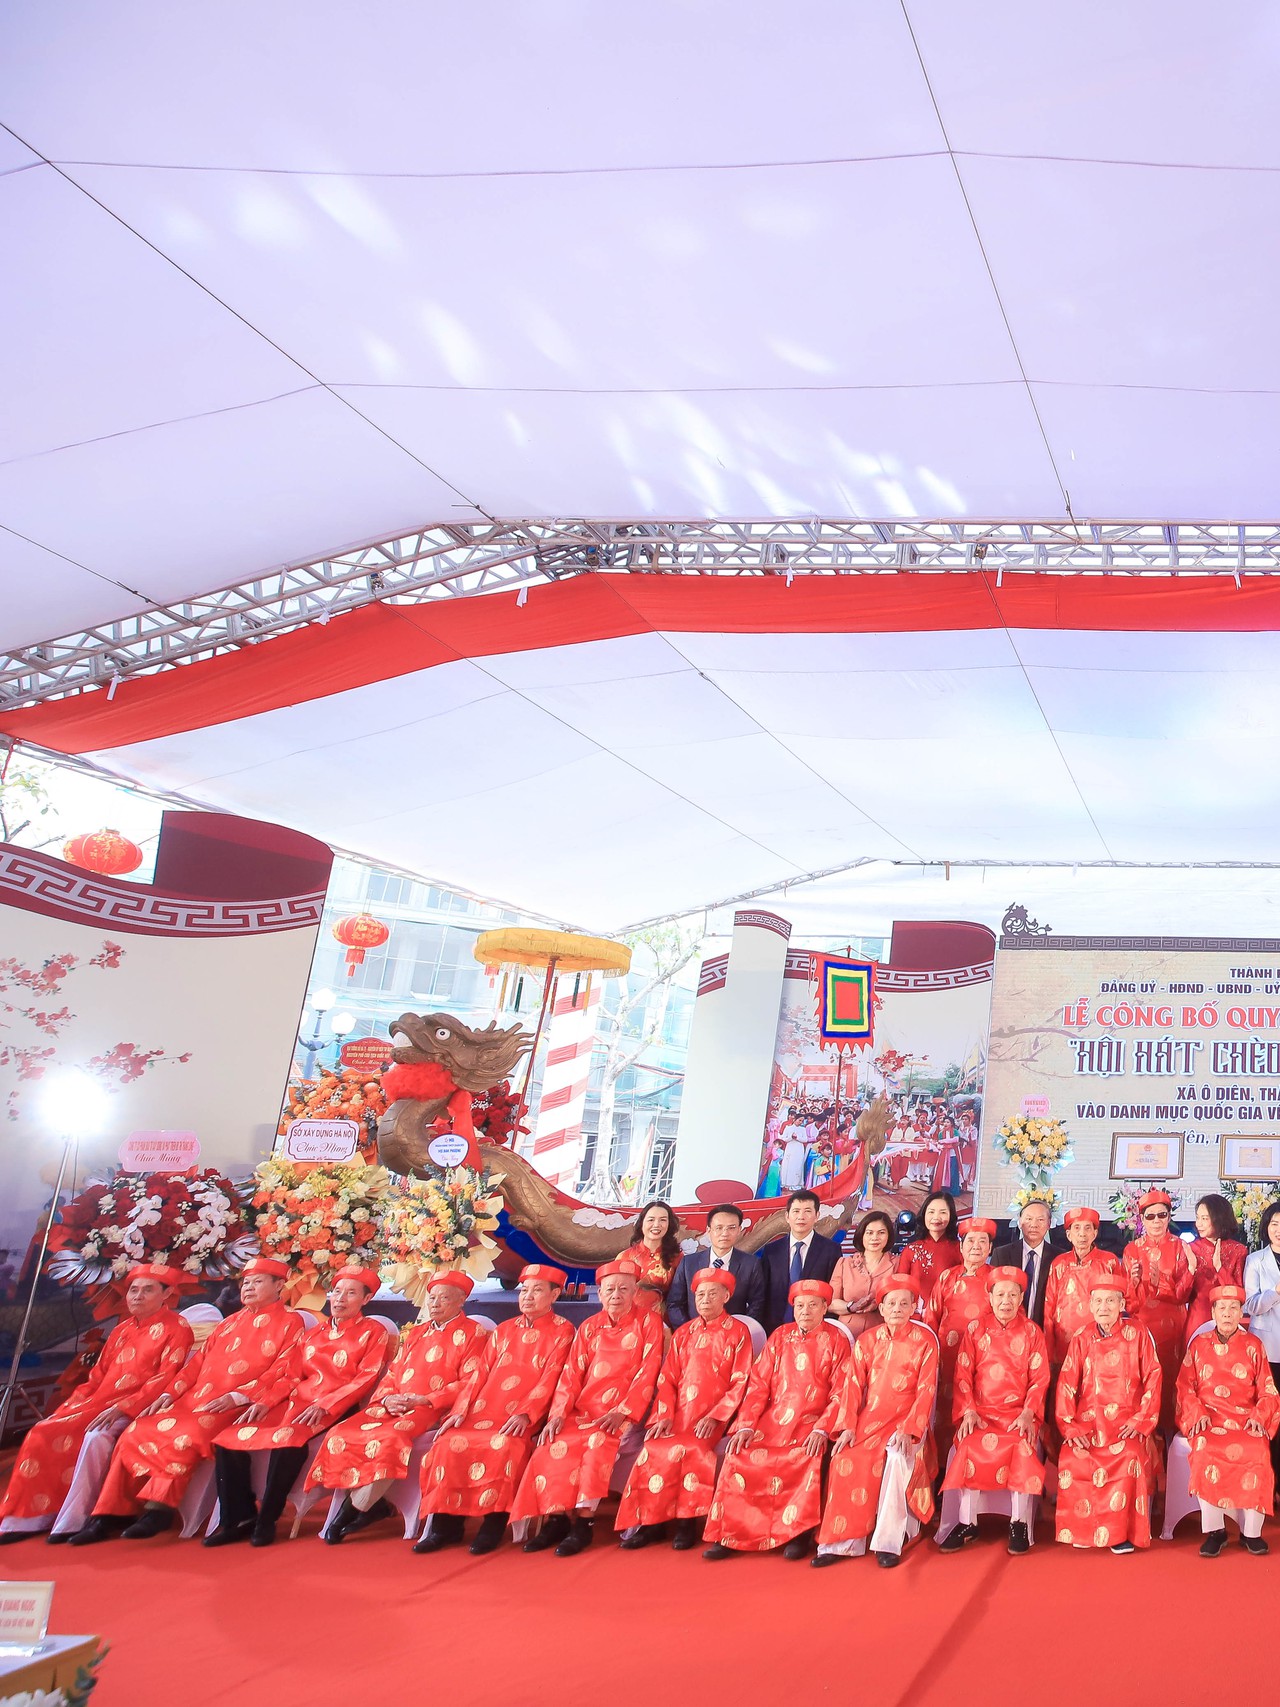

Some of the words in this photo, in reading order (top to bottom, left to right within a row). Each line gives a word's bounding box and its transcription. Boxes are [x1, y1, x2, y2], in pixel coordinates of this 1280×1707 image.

[1230, 967, 1273, 979] THÀNH
[1101, 979, 1136, 994] ĐẢNG
[1140, 979, 1157, 994] UỶ
[1169, 984, 1204, 994] HĐND
[1217, 984, 1252, 995] UBND
[1063, 997, 1089, 1027] LỄ
[1096, 1001, 1173, 1028] CÔNG
[1181, 1000, 1218, 1028] BỐ
[1069, 1035, 1126, 1077] "HỘI
[1135, 1036, 1202, 1075] HÁT
[1177, 1085, 1196, 1101] XÃ
[1201, 1084, 1211, 1101] Ô
[1216, 1085, 1255, 1103] DIÊN,
[1077, 1103, 1105, 1119] VÀO
[1110, 1105, 1151, 1119] DANH
[1155, 1105, 1189, 1123] MỤC
[1193, 1101, 1233, 1120] QUỐC
[1238, 1106, 1263, 1120] GIA
